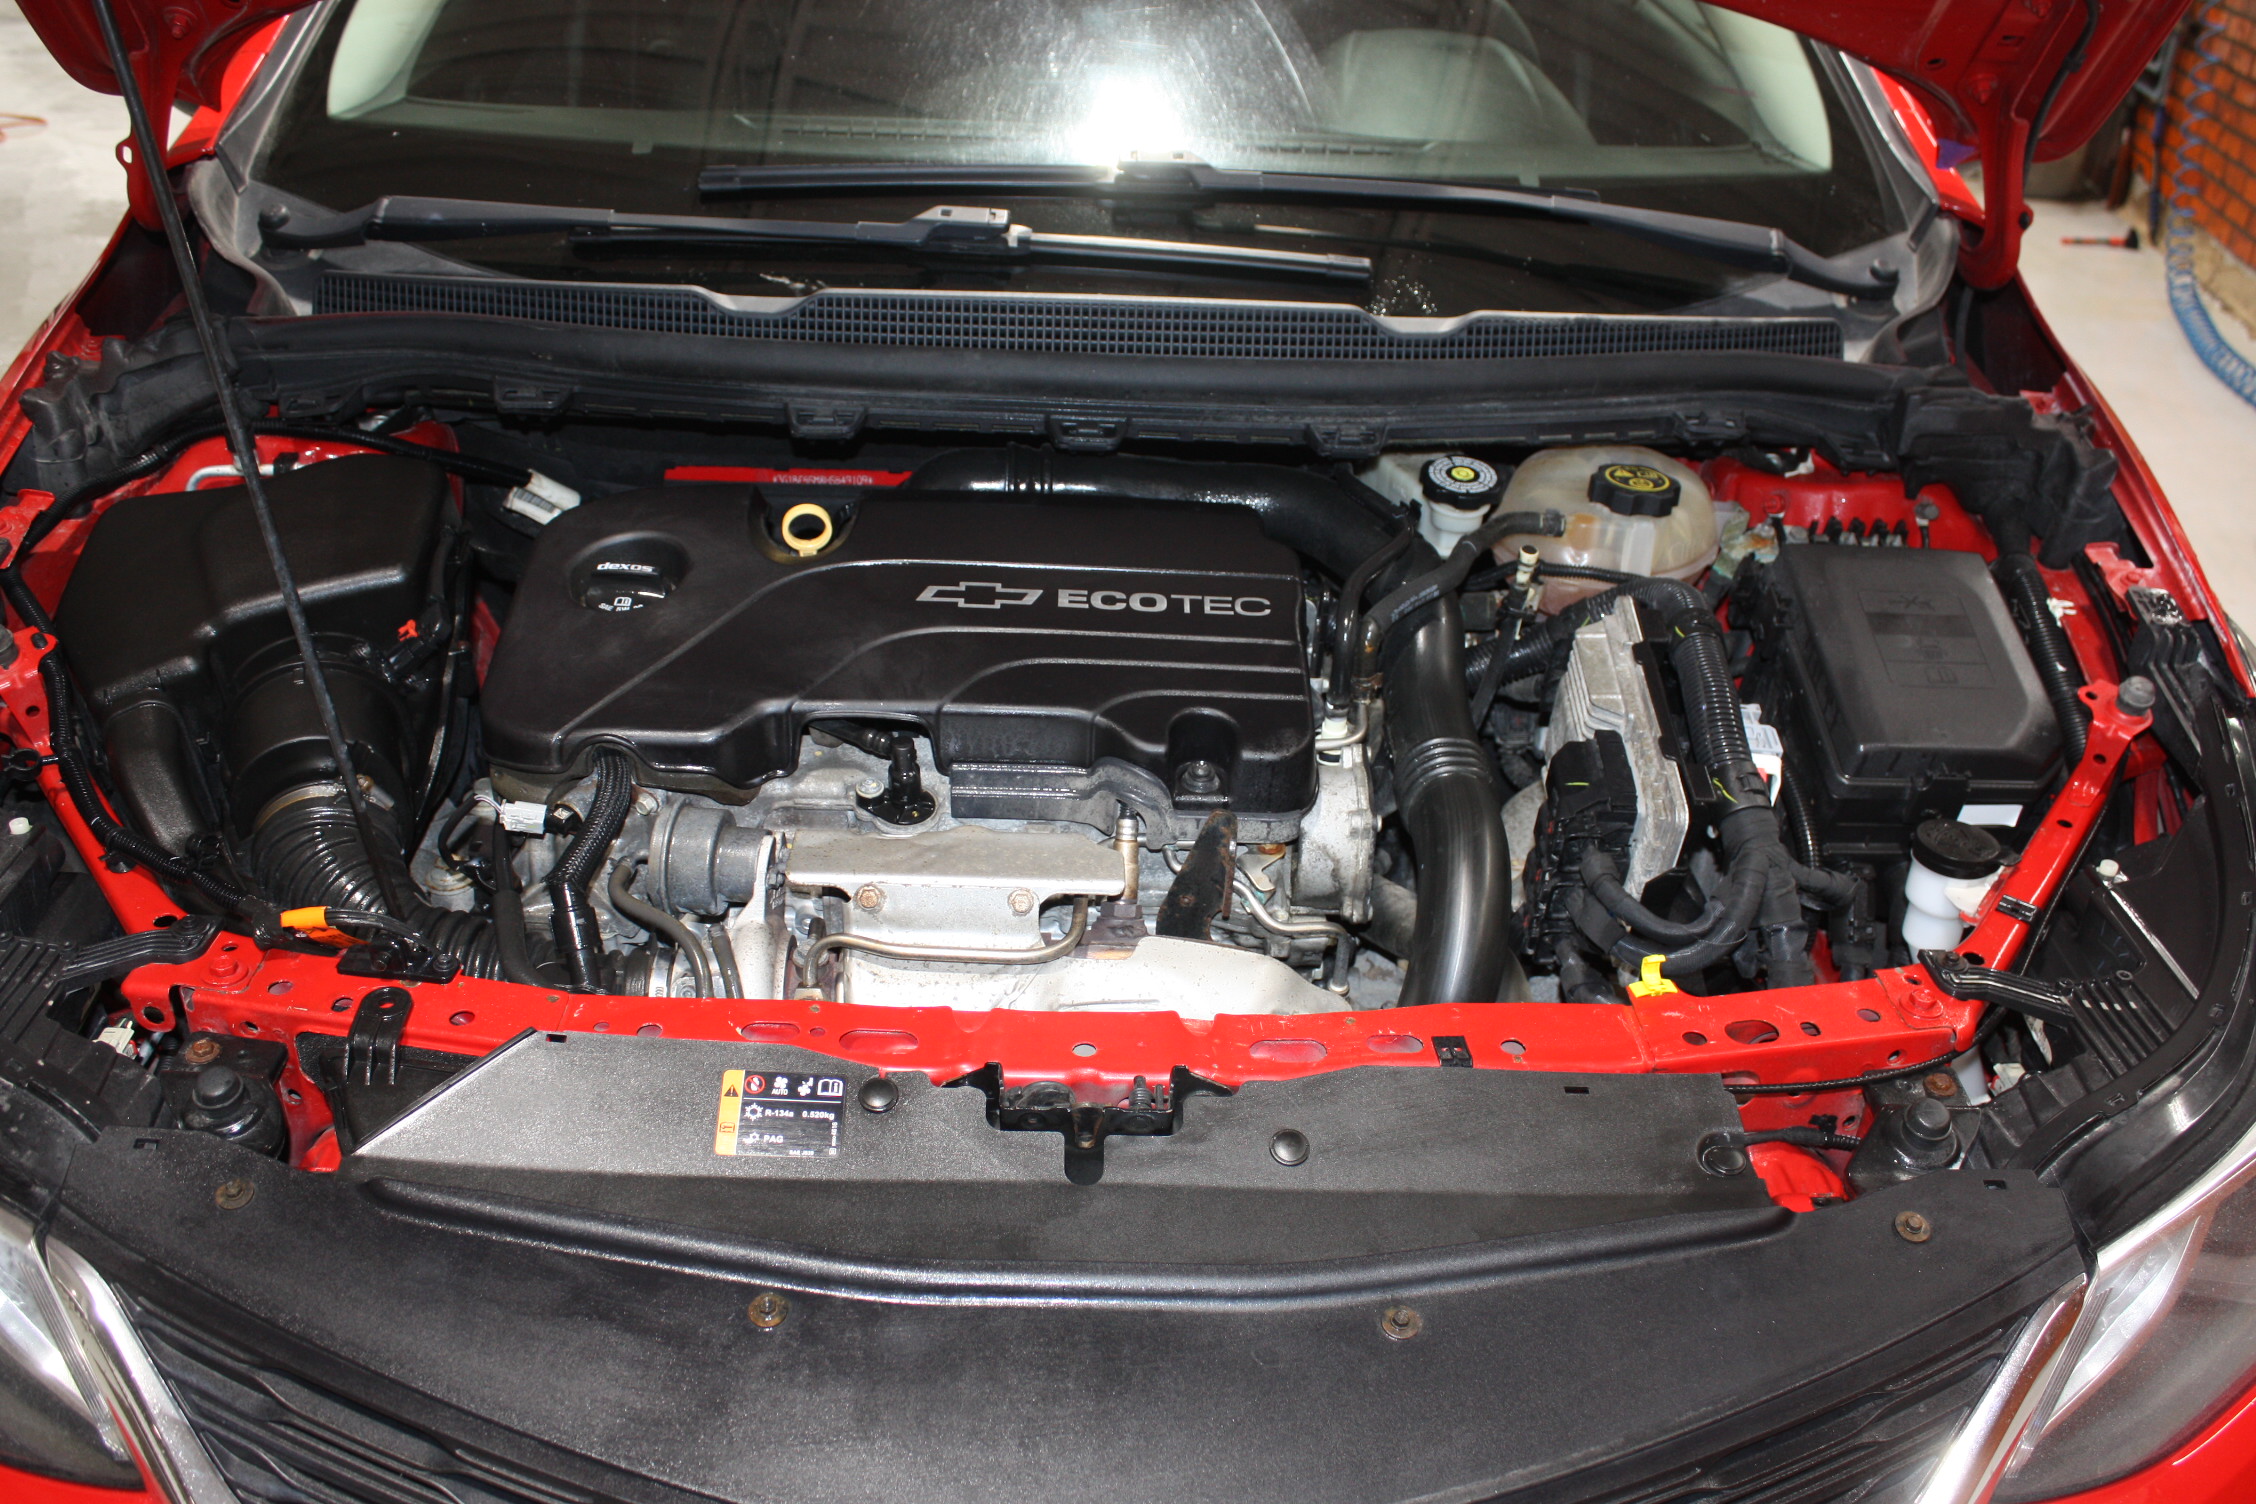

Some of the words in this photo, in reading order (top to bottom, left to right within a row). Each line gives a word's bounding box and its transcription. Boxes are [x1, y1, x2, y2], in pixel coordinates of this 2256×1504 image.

[596, 562, 655, 572] dexos
[1057, 588, 1272, 617] ECOTEC
[764, 1109, 794, 1118] R-134a
[802, 1110, 835, 1121] 0.520kg
[763, 1134, 784, 1144] PAG
